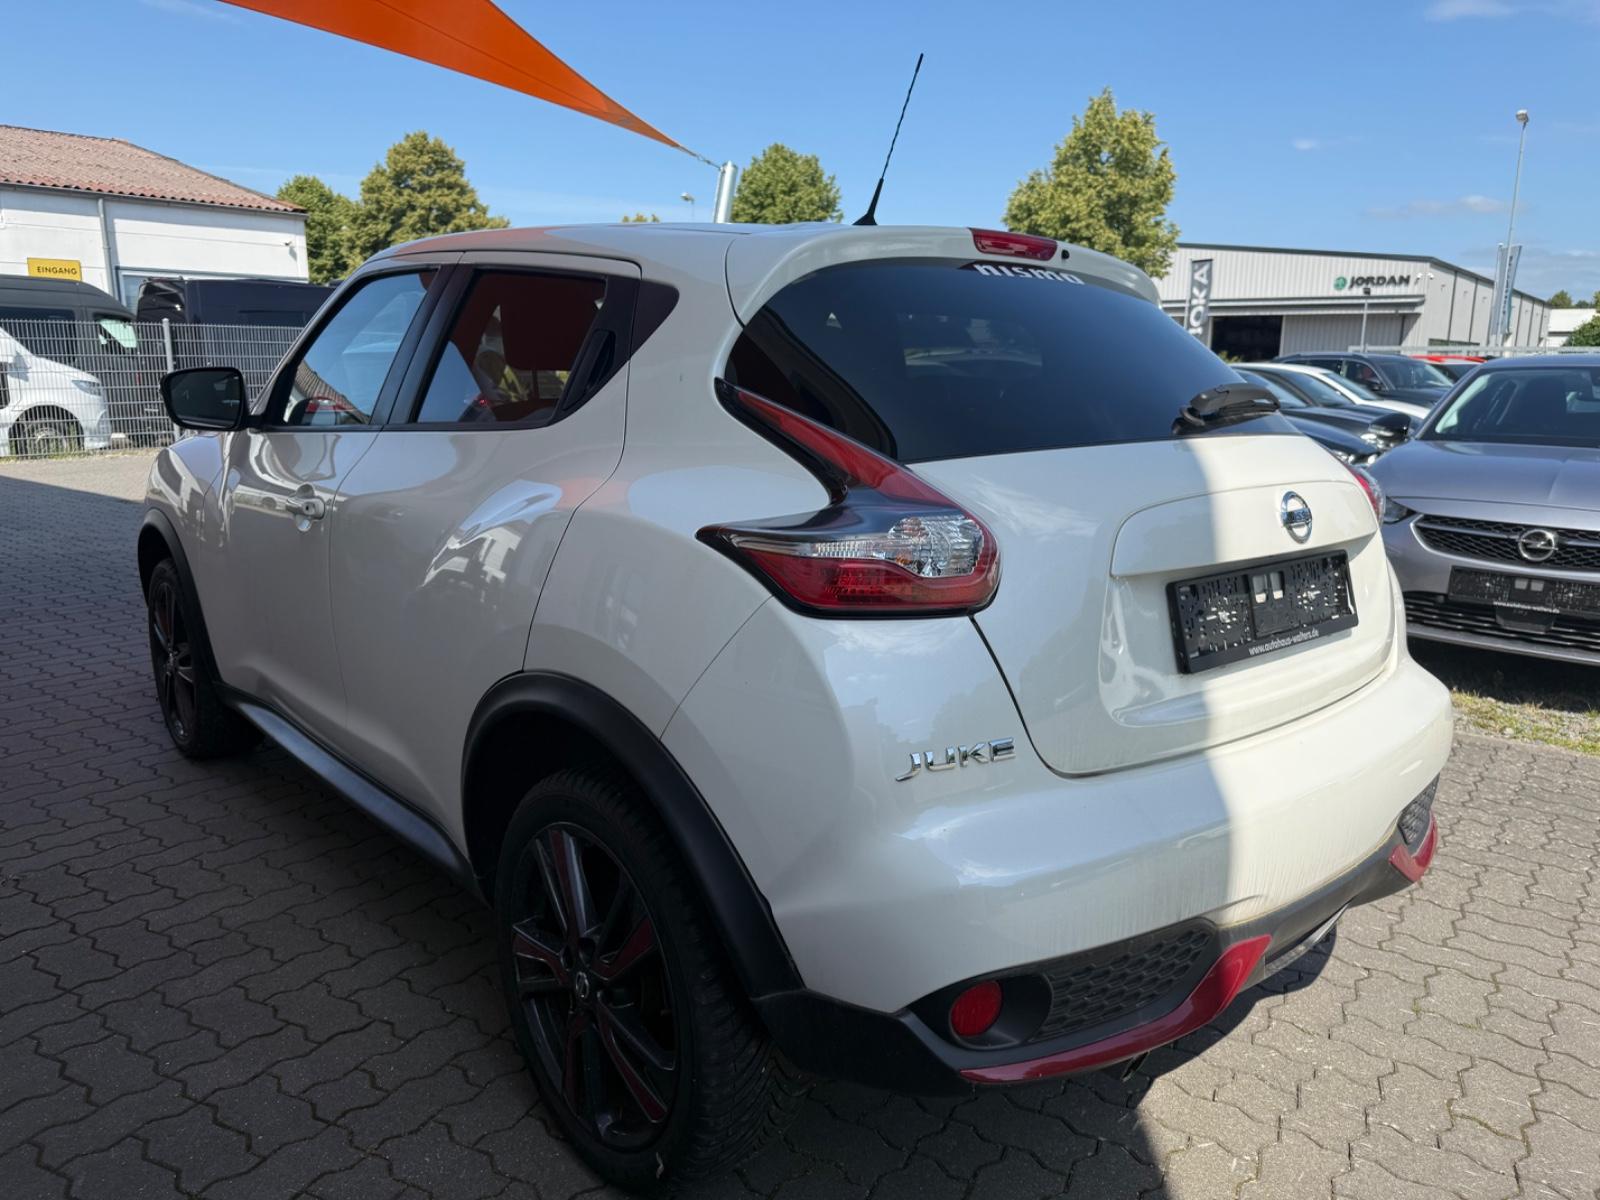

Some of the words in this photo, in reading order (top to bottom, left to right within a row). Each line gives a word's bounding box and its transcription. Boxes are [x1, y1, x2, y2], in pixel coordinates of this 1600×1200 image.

[36, 266, 78, 275] EINGANG
[973, 264, 1085, 285] nismo
[1348, 275, 1411, 290] JORDAN
[895, 737, 1016, 782] JUKE
